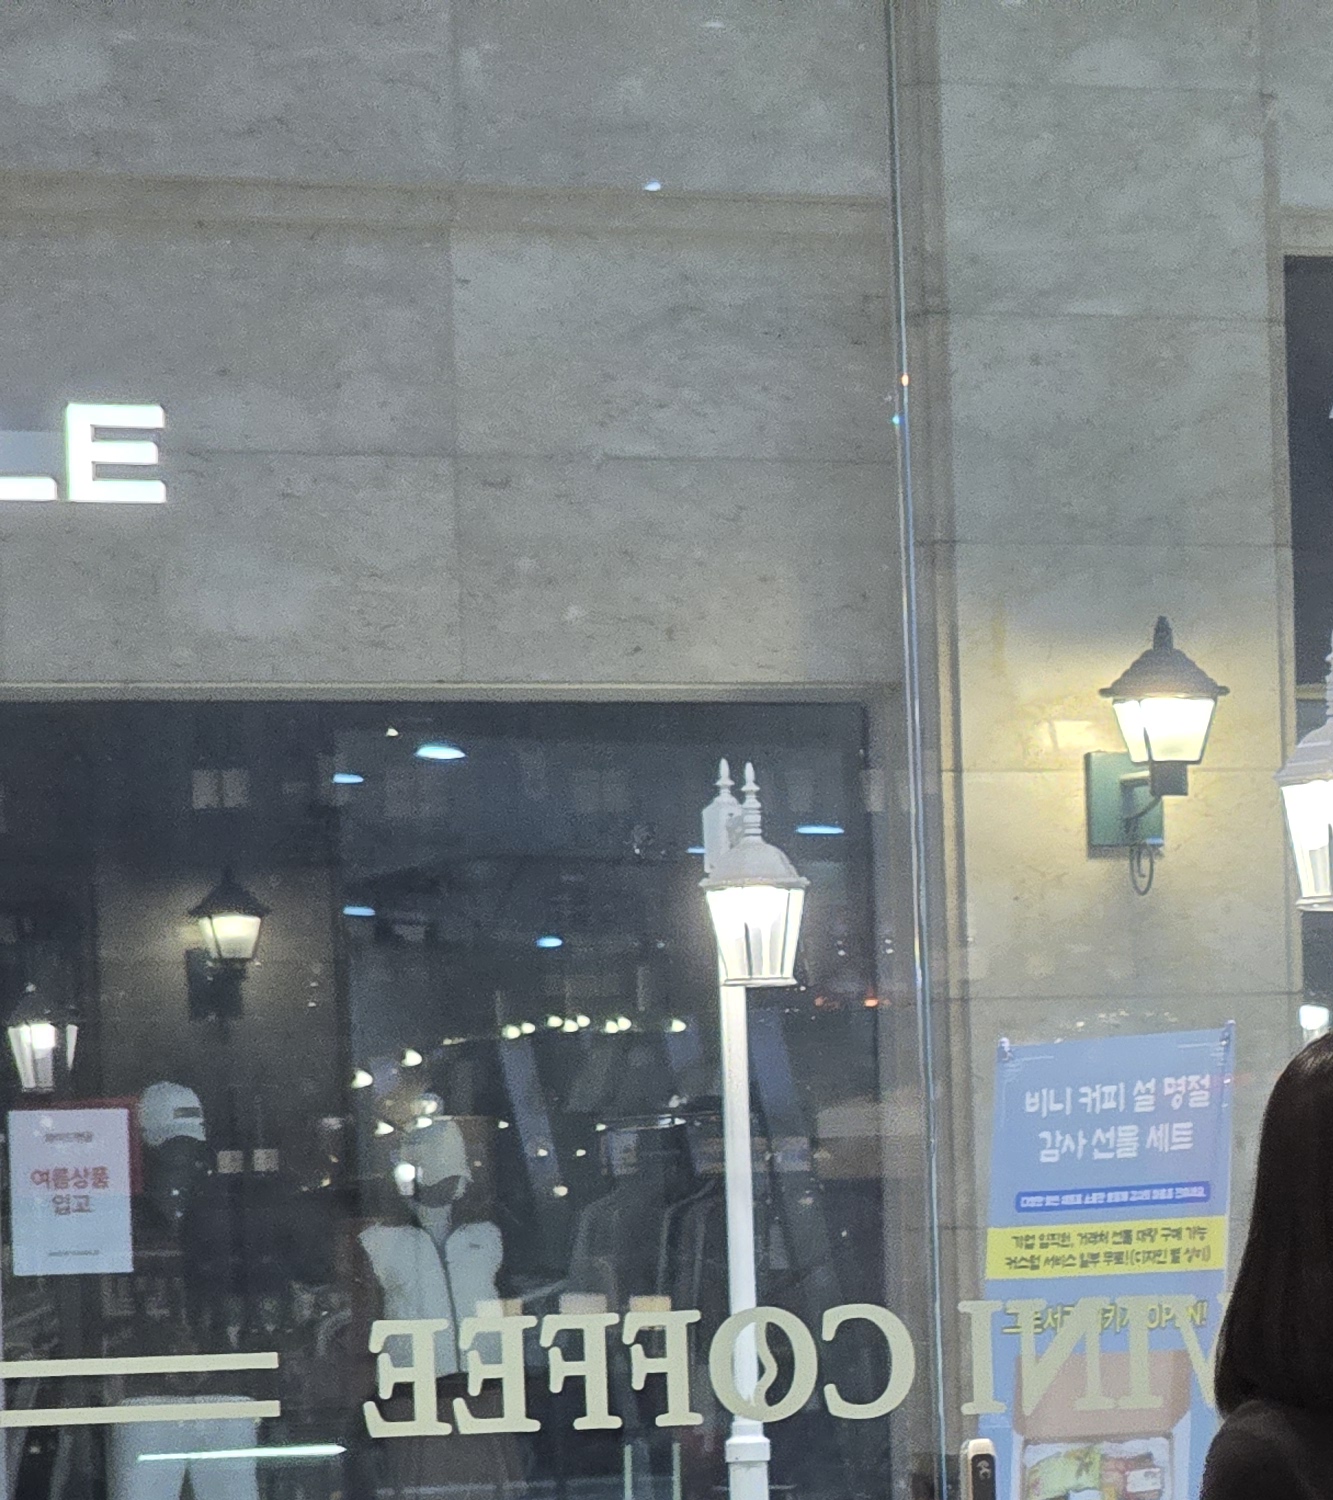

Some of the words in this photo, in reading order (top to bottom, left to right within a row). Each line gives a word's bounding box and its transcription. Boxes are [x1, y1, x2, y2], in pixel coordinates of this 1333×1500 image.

[1024, 1087, 1072, 1118] 비니
[1078, 1083, 1126, 1114] 커피
[1133, 1077, 1156, 1112] 설
[1163, 1073, 1211, 1110] 명절
[1038, 1129, 1087, 1163] 감사
[1091, 1124, 1139, 1160] 선물
[1145, 1121, 1194, 1153] 세트
[30, 1166, 109, 1190] 여름상품
